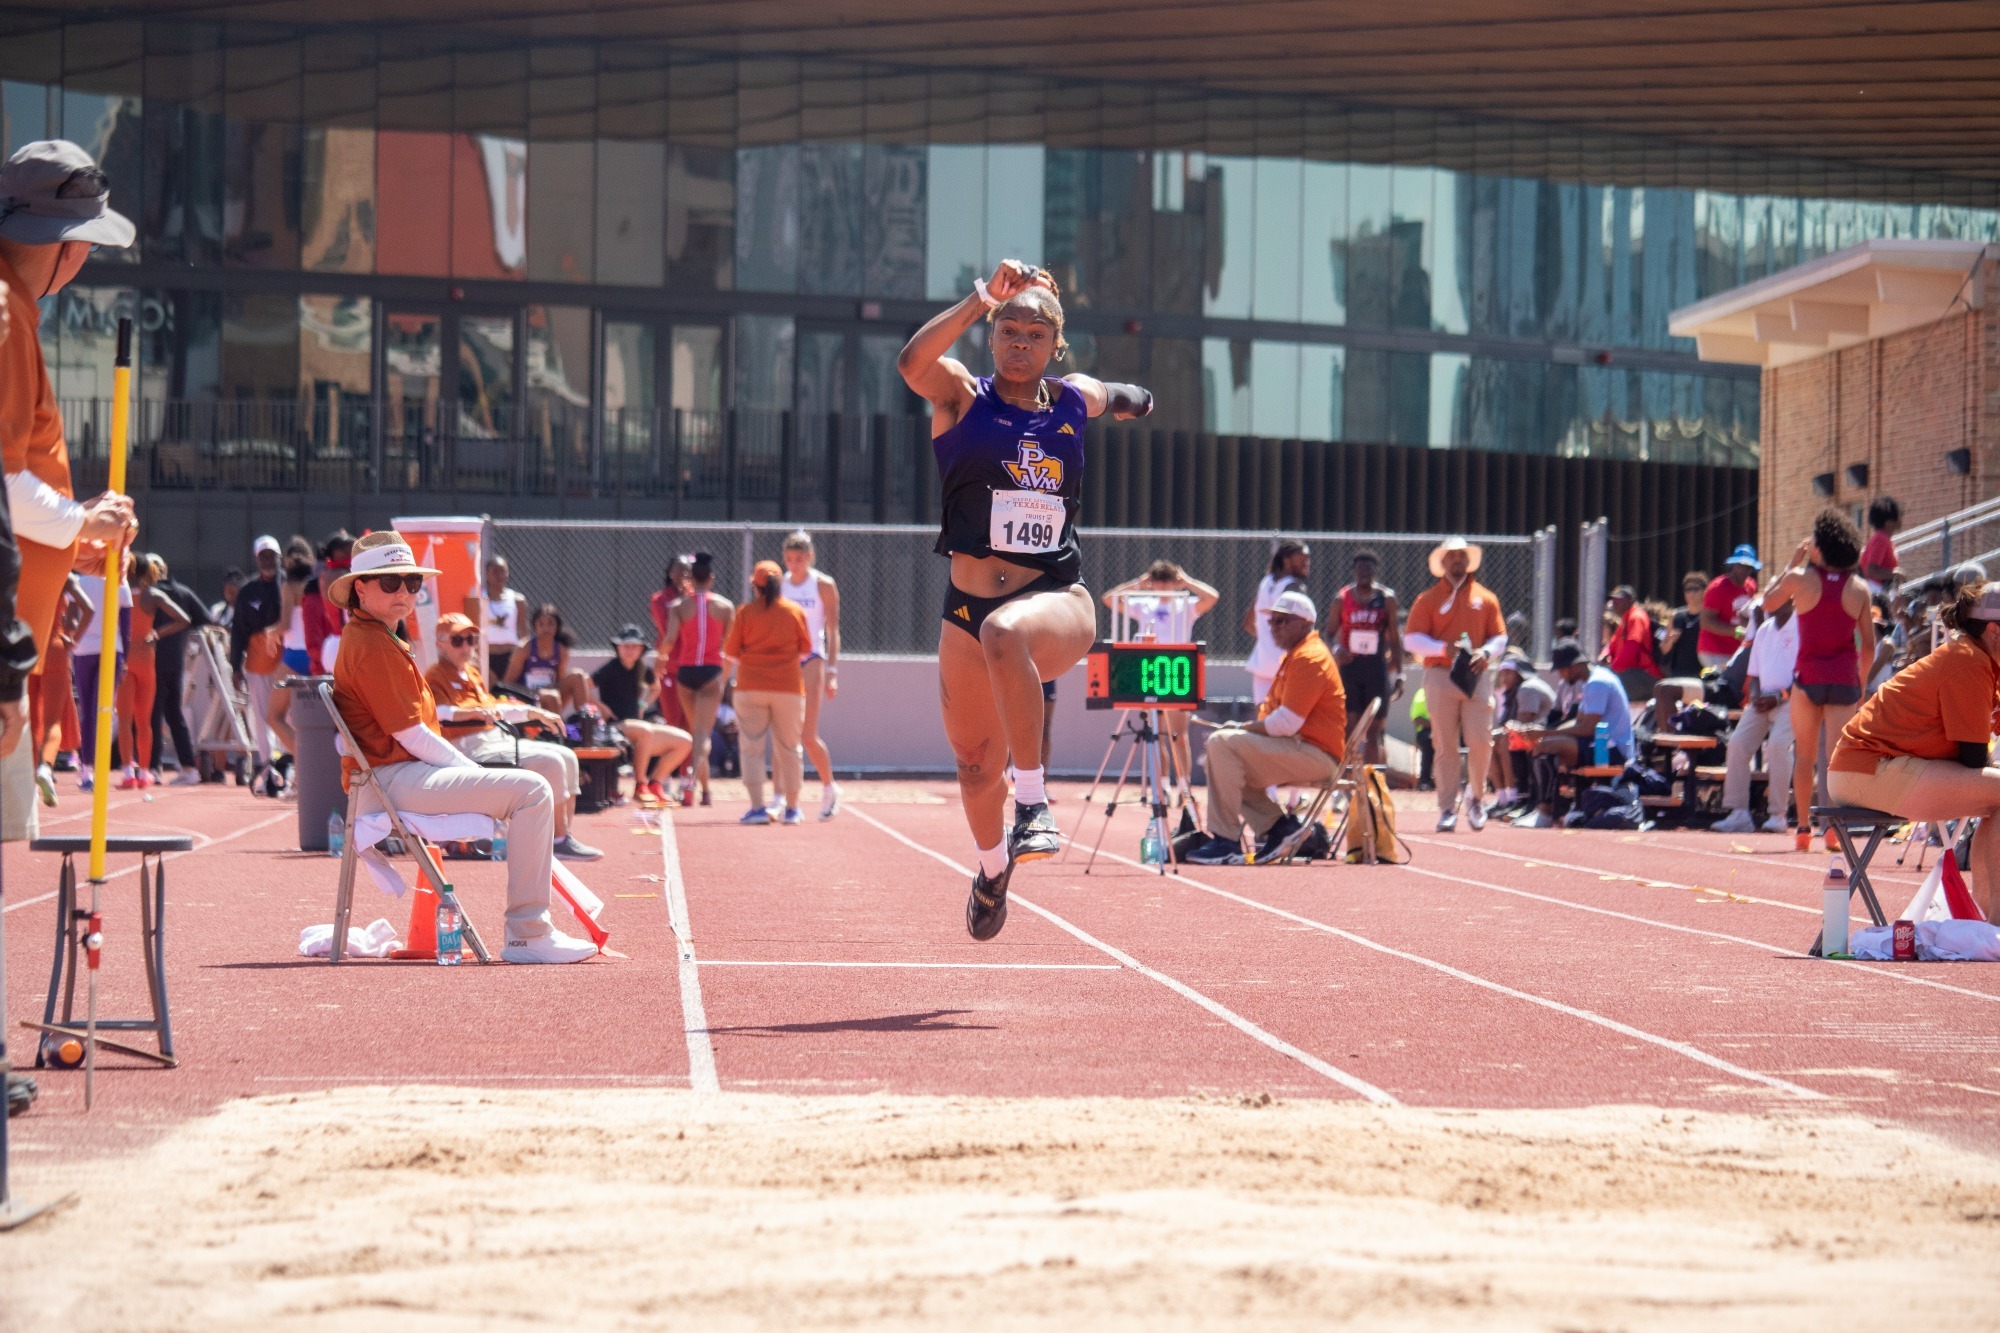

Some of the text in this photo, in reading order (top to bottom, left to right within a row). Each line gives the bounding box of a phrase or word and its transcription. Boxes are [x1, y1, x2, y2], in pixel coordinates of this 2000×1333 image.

[1012, 501, 1040, 510] TEXAS
[1025, 513, 1046, 521] TRUIST
[1003, 520, 1053, 549] 1499
[1141, 655, 1190, 696] 1:00
[507, 940, 528, 948] HOKA
